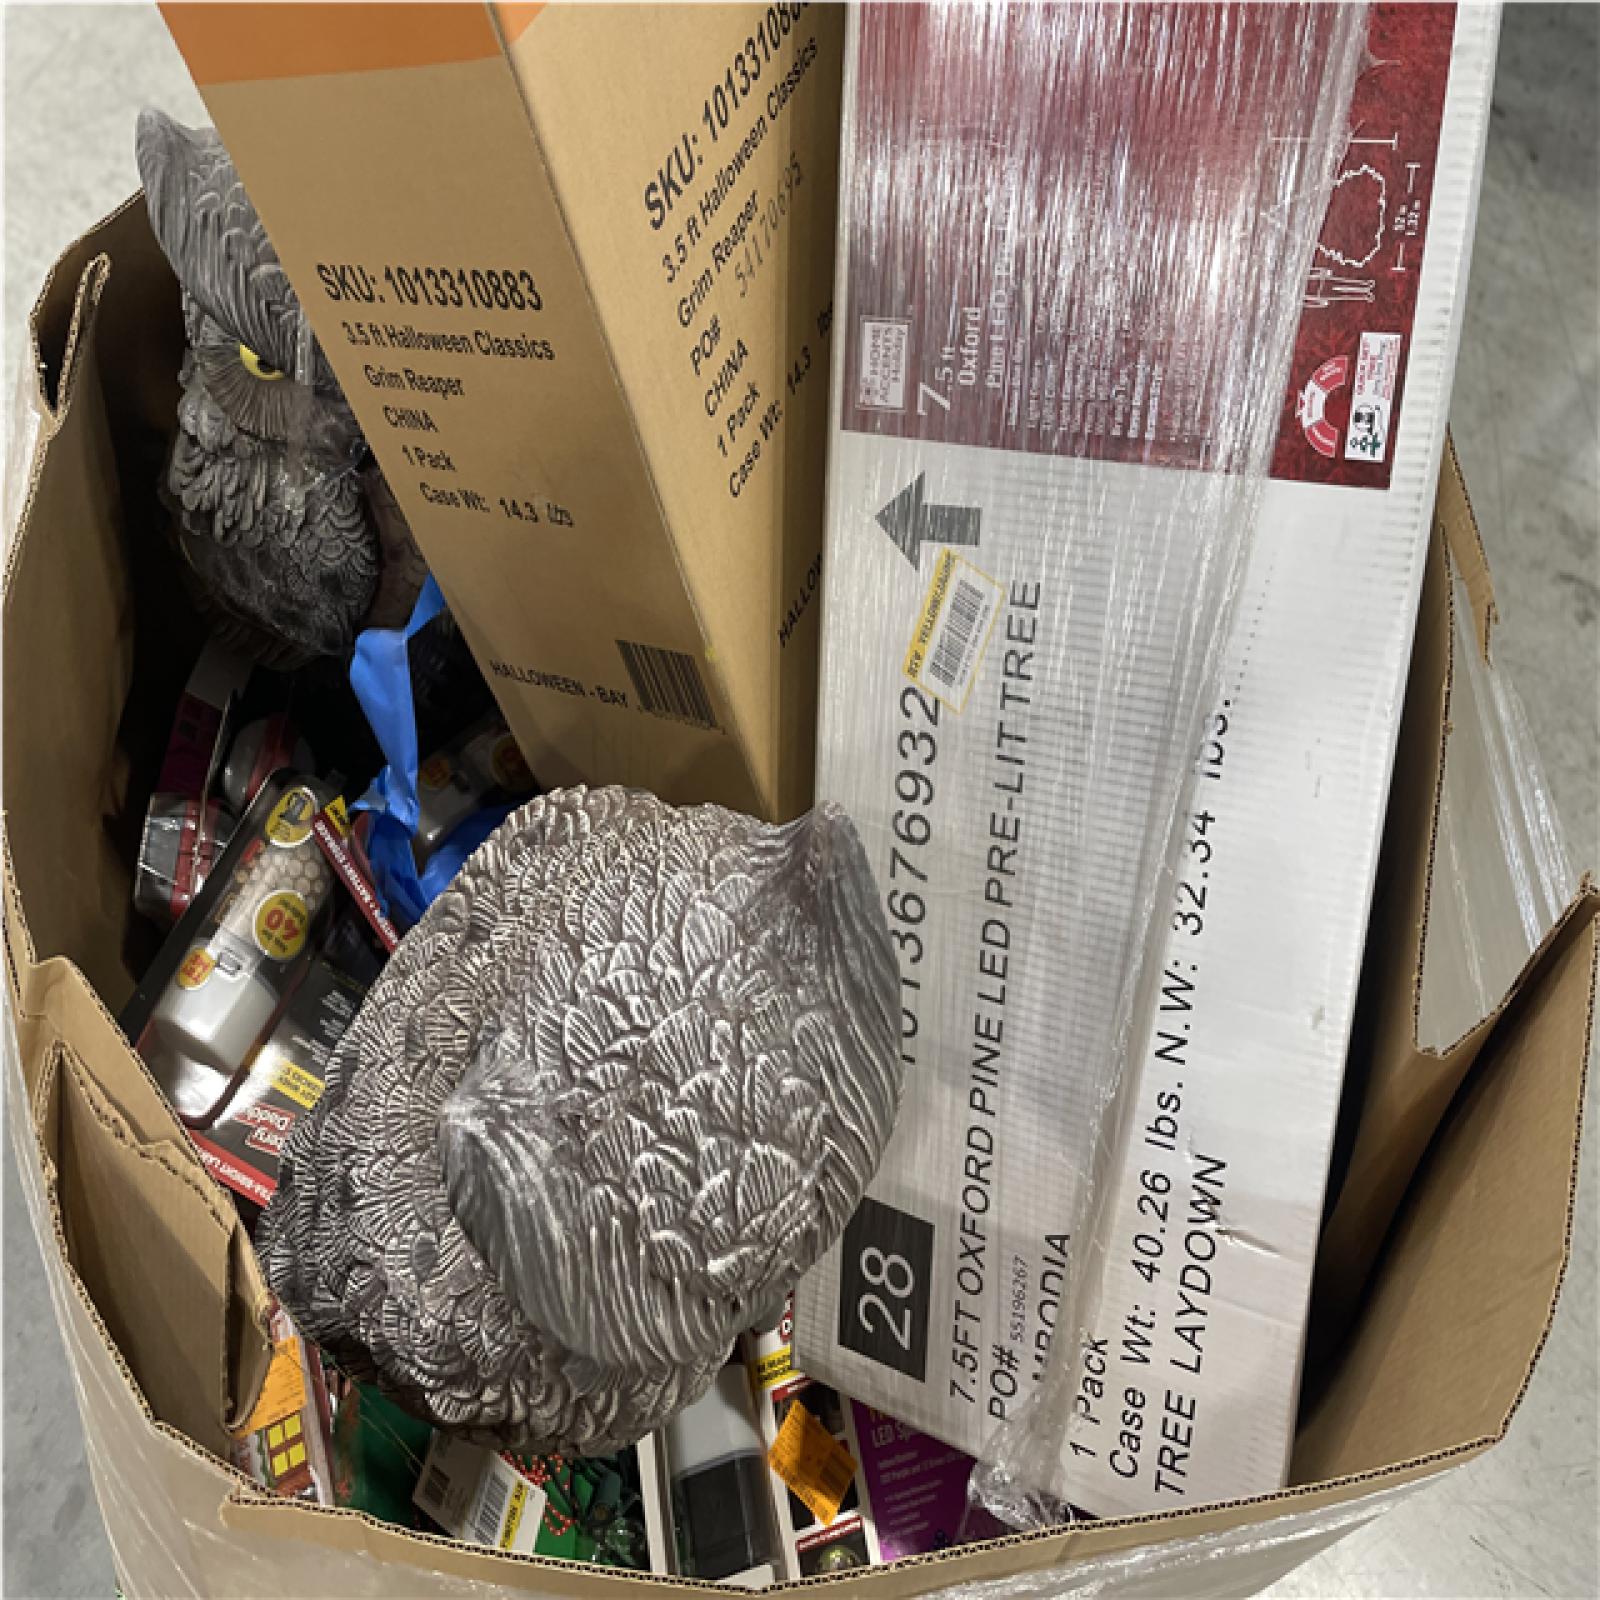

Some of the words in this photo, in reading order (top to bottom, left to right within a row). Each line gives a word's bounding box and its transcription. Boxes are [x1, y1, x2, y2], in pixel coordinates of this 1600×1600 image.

[645, 132, 703, 230] SKU:
[317, 264, 385, 303] SKU:
[385, 266, 543, 310] 1013310883
[678, 268, 713, 328] Grim
[364, 365, 405, 389] Grim
[404, 368, 465, 400] Reaper
[384, 325, 475, 354] Halloween
[474, 330, 555, 361] Classics
[704, 337, 749, 417] CHINA
[956, 306, 982, 386] Oxford
[383, 405, 439, 433] CHINA
[414, 447, 457, 472] Pack
[420, 482, 453, 507] Case
[1000, 579, 1041, 711] TREE
[984, 720, 1028, 908] PRE-LIT
[1172, 808, 1216, 936] 32.34
[977, 919, 1011, 1006] LED
[970, 1012, 1003, 1118] PINE
[1145, 1080, 1185, 1151] lbs.
[957, 1124, 994, 1296] OXFORD
[1131, 1168, 1172, 1284] 40.26
[858, 1246, 914, 1351] 28
[1169, 1153, 1228, 1376] LAYDOWN
[950, 1299, 981, 1403] 7.5FT
[1120, 1304, 1157, 1366] Wt:
[987, 1344, 1020, 1421] PO#
[1074, 1336, 1109, 1425] Pack
[1070, 1440, 1098, 1457] 1
[1109, 1386, 1147, 1479] Case
[1155, 1389, 1197, 1496] TREE
